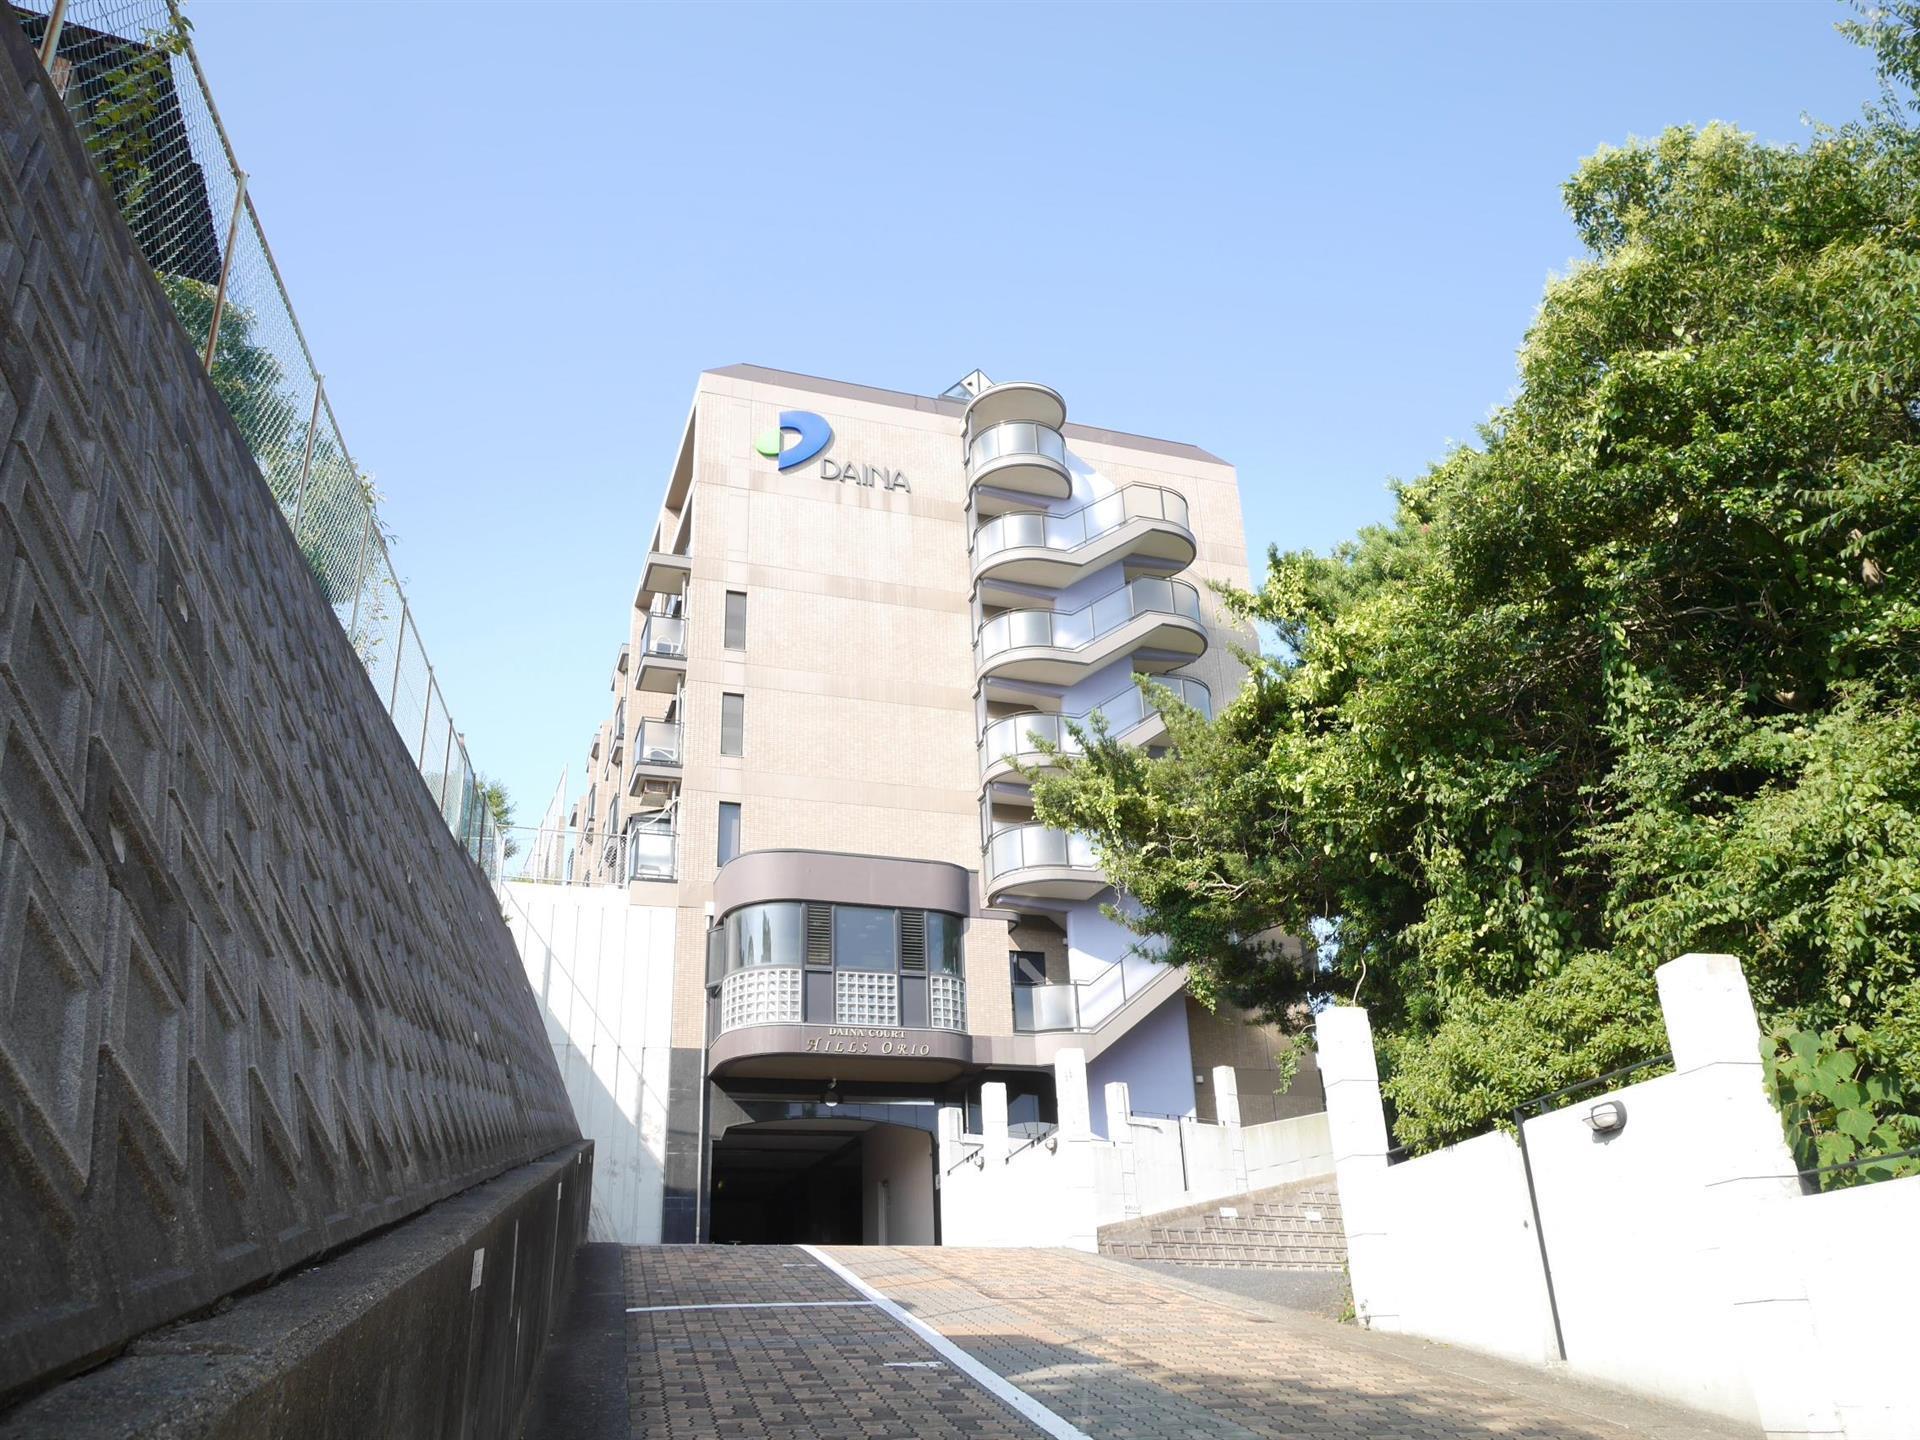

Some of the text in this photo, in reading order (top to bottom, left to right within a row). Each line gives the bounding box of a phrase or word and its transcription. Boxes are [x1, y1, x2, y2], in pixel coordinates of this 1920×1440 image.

[821, 458, 912, 494] DAINA
[829, 1027, 906, 1039] DAINA COURT
[806, 1036, 930, 1056] HILLS ORIO
